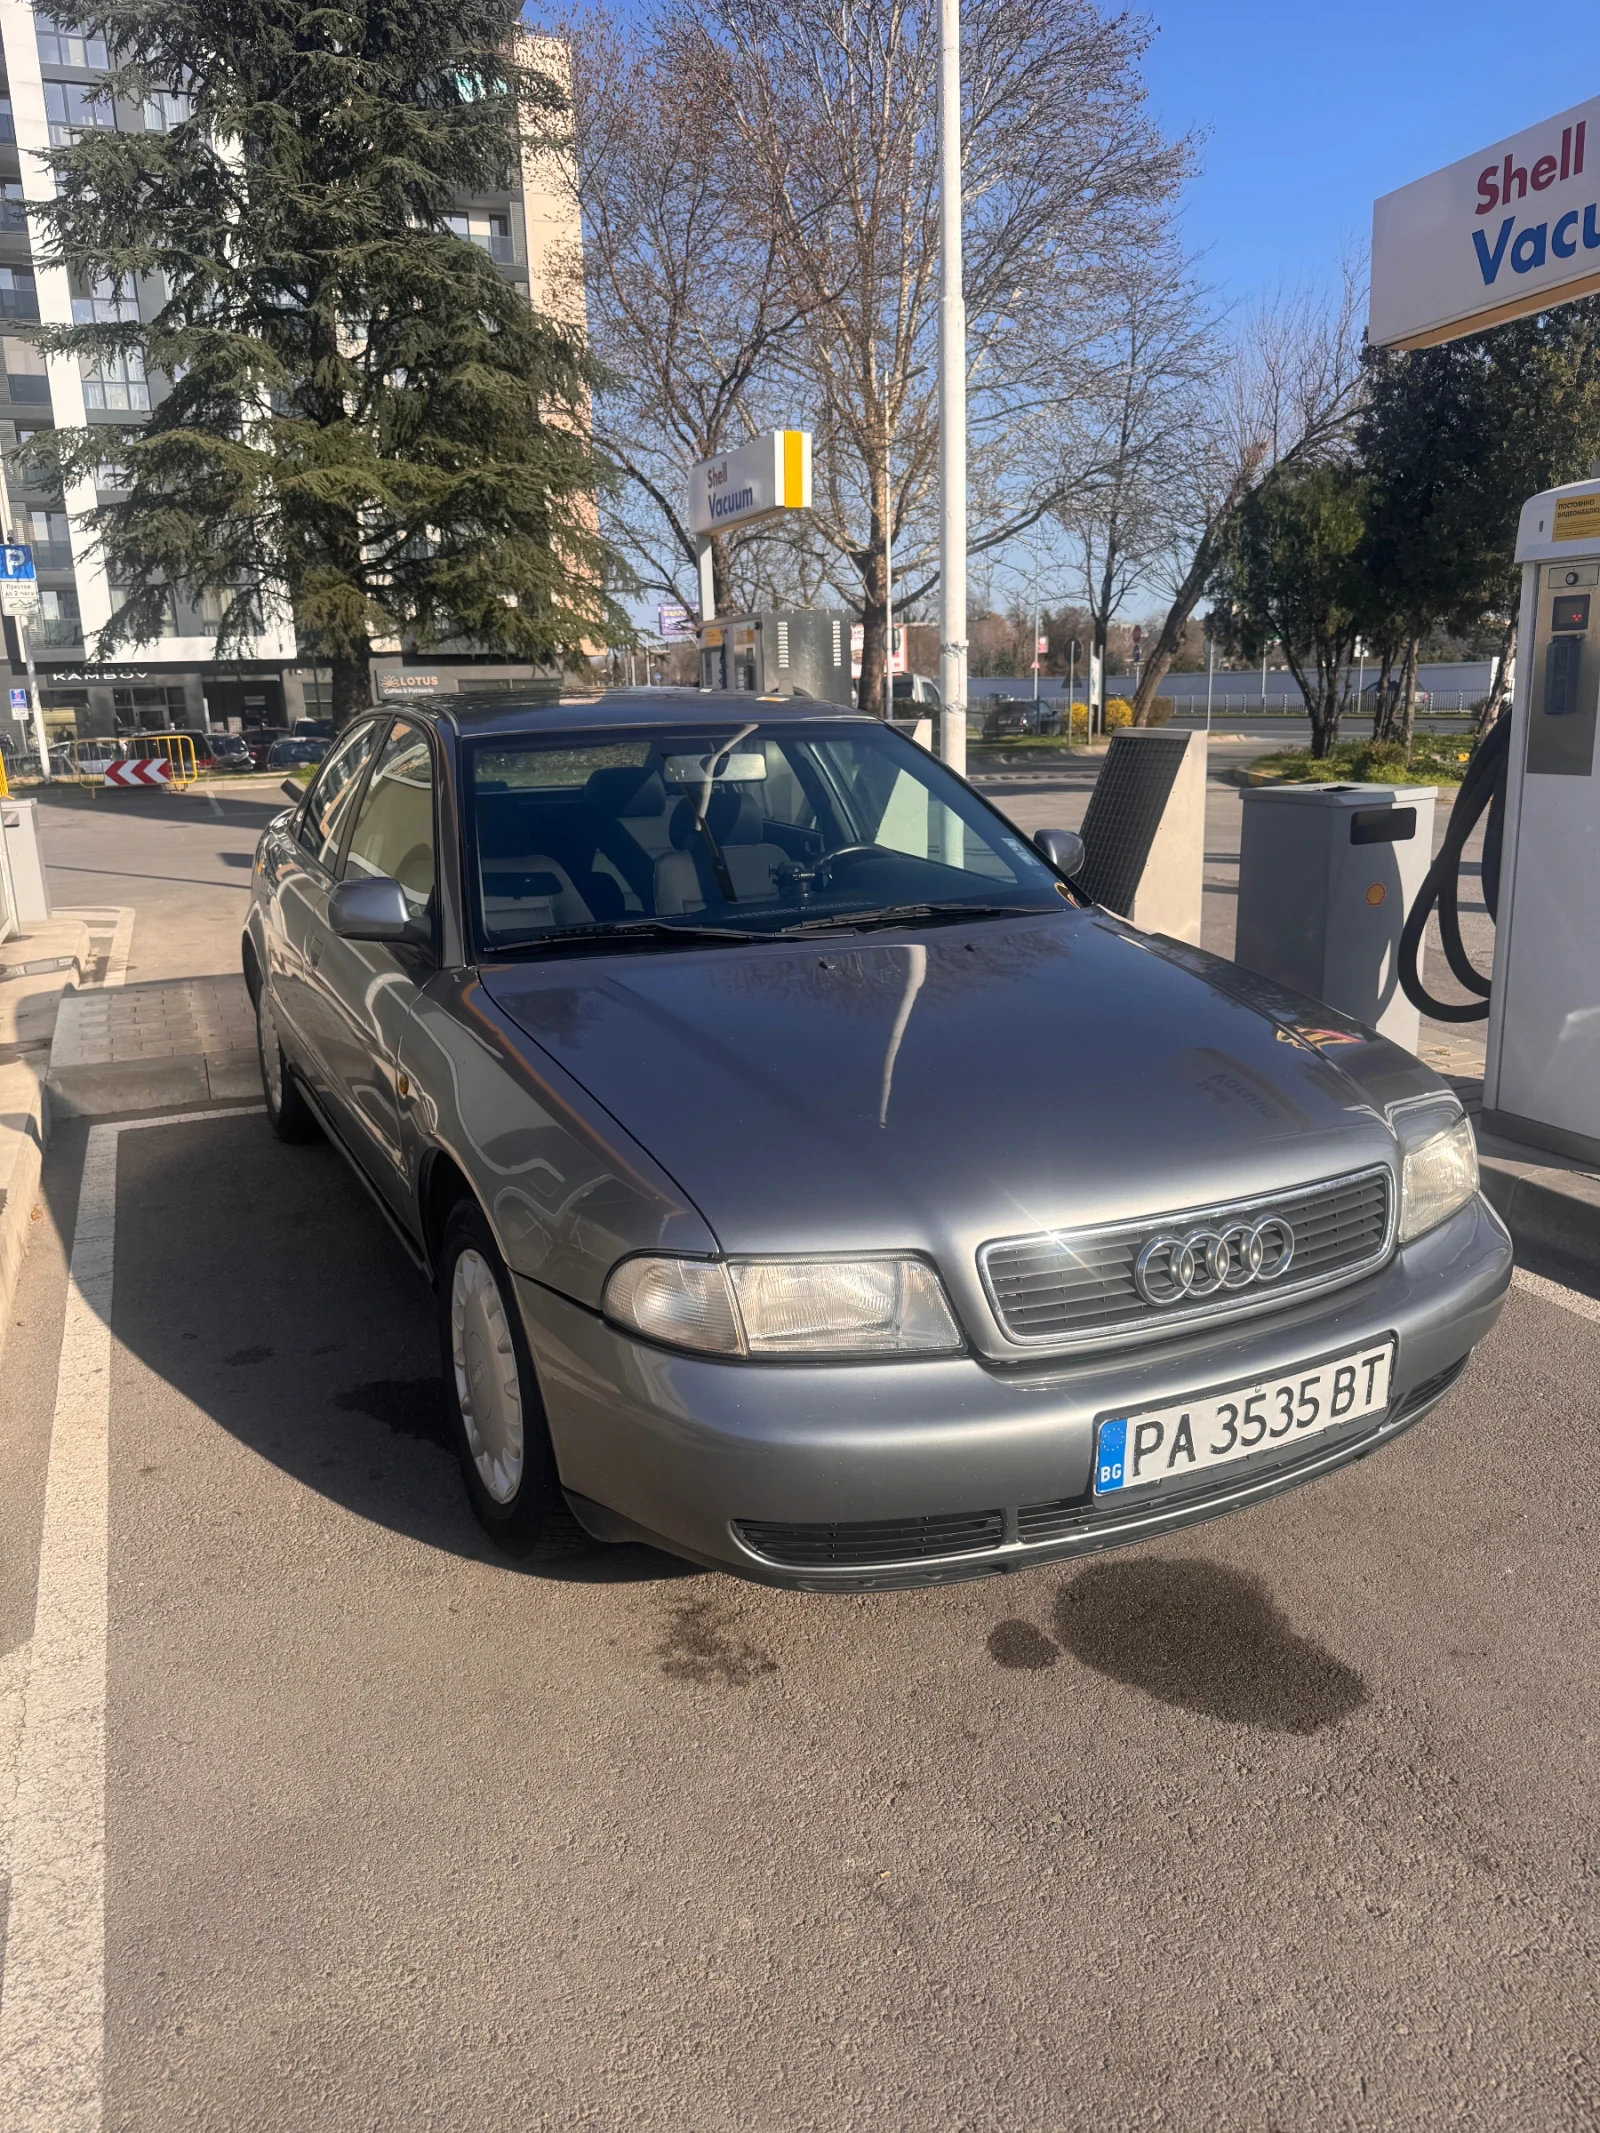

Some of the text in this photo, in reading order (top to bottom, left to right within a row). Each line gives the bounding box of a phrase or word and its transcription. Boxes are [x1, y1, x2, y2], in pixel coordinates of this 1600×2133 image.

[1475, 120, 1587, 215] Shell
[708, 461, 728, 489] Shell
[708, 486, 753, 520] Vacuum
[1557, 507, 1600, 518] ВИДЕОНАБЛЮ
[1558, 499, 1595, 510] ПОСТОЯННО
[5, 548, 26, 576] P
[53, 672, 148, 681] KAMBOV
[400, 676, 438, 686] LOTUS
[1132, 1353, 1386, 1477] PA 3535 BT
[1100, 1463, 1122, 1483] BG
